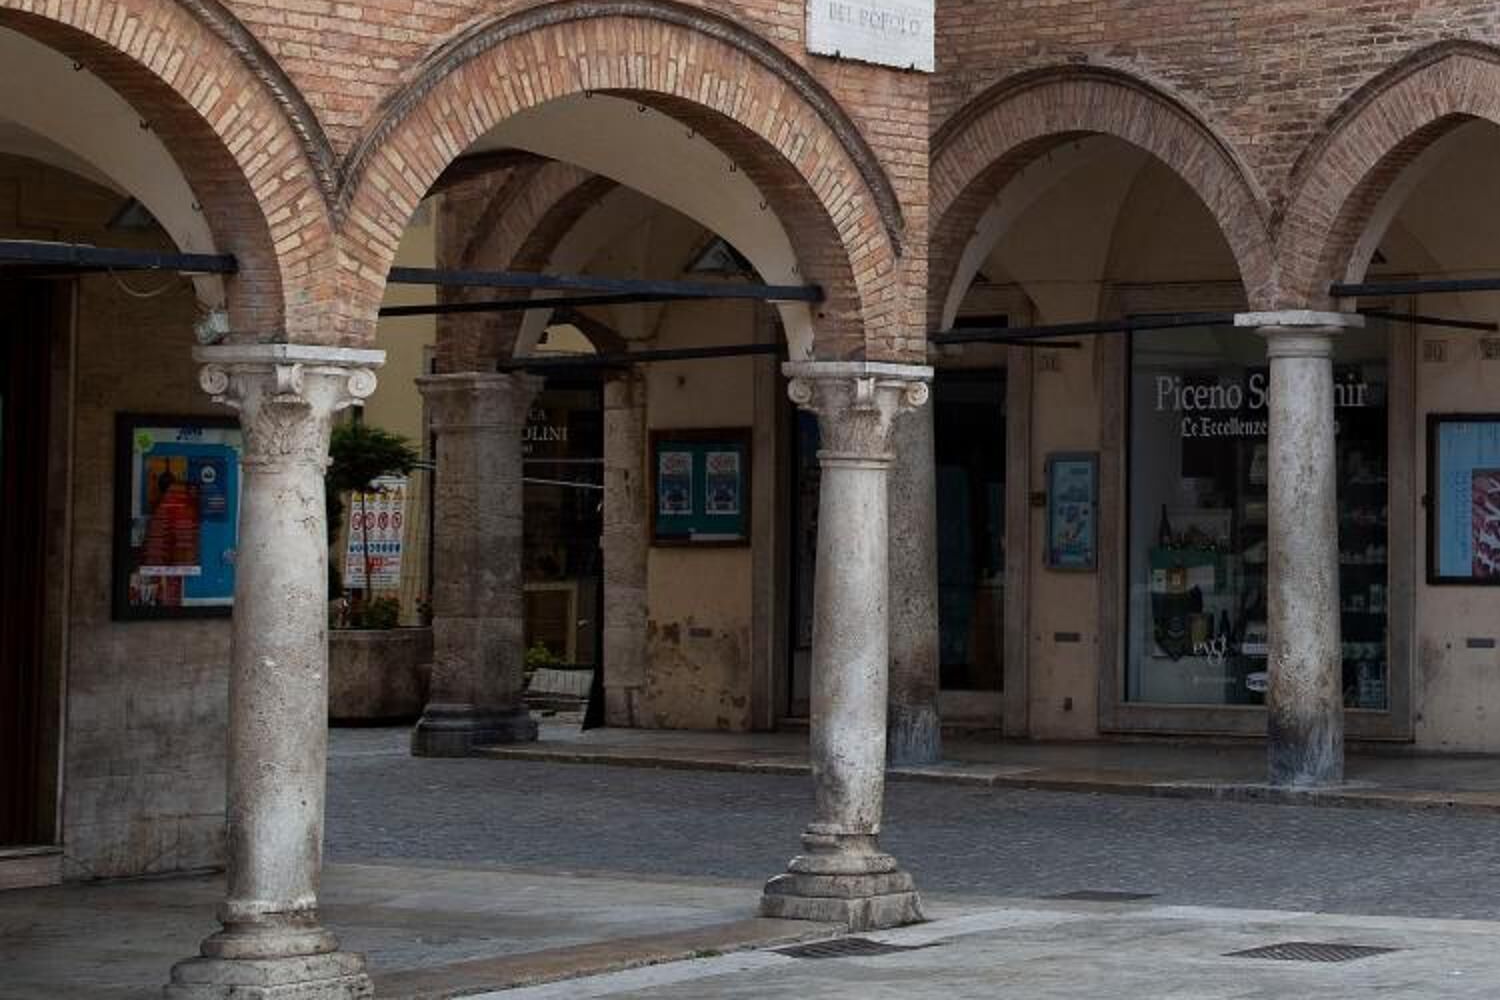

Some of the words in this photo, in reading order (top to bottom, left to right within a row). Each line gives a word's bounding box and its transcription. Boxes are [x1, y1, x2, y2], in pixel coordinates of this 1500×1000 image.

[1155, 375, 1242, 410] Piceno
[1248, 373, 1367, 408] Snir
[1200, 416, 1267, 437] Eccellenze
